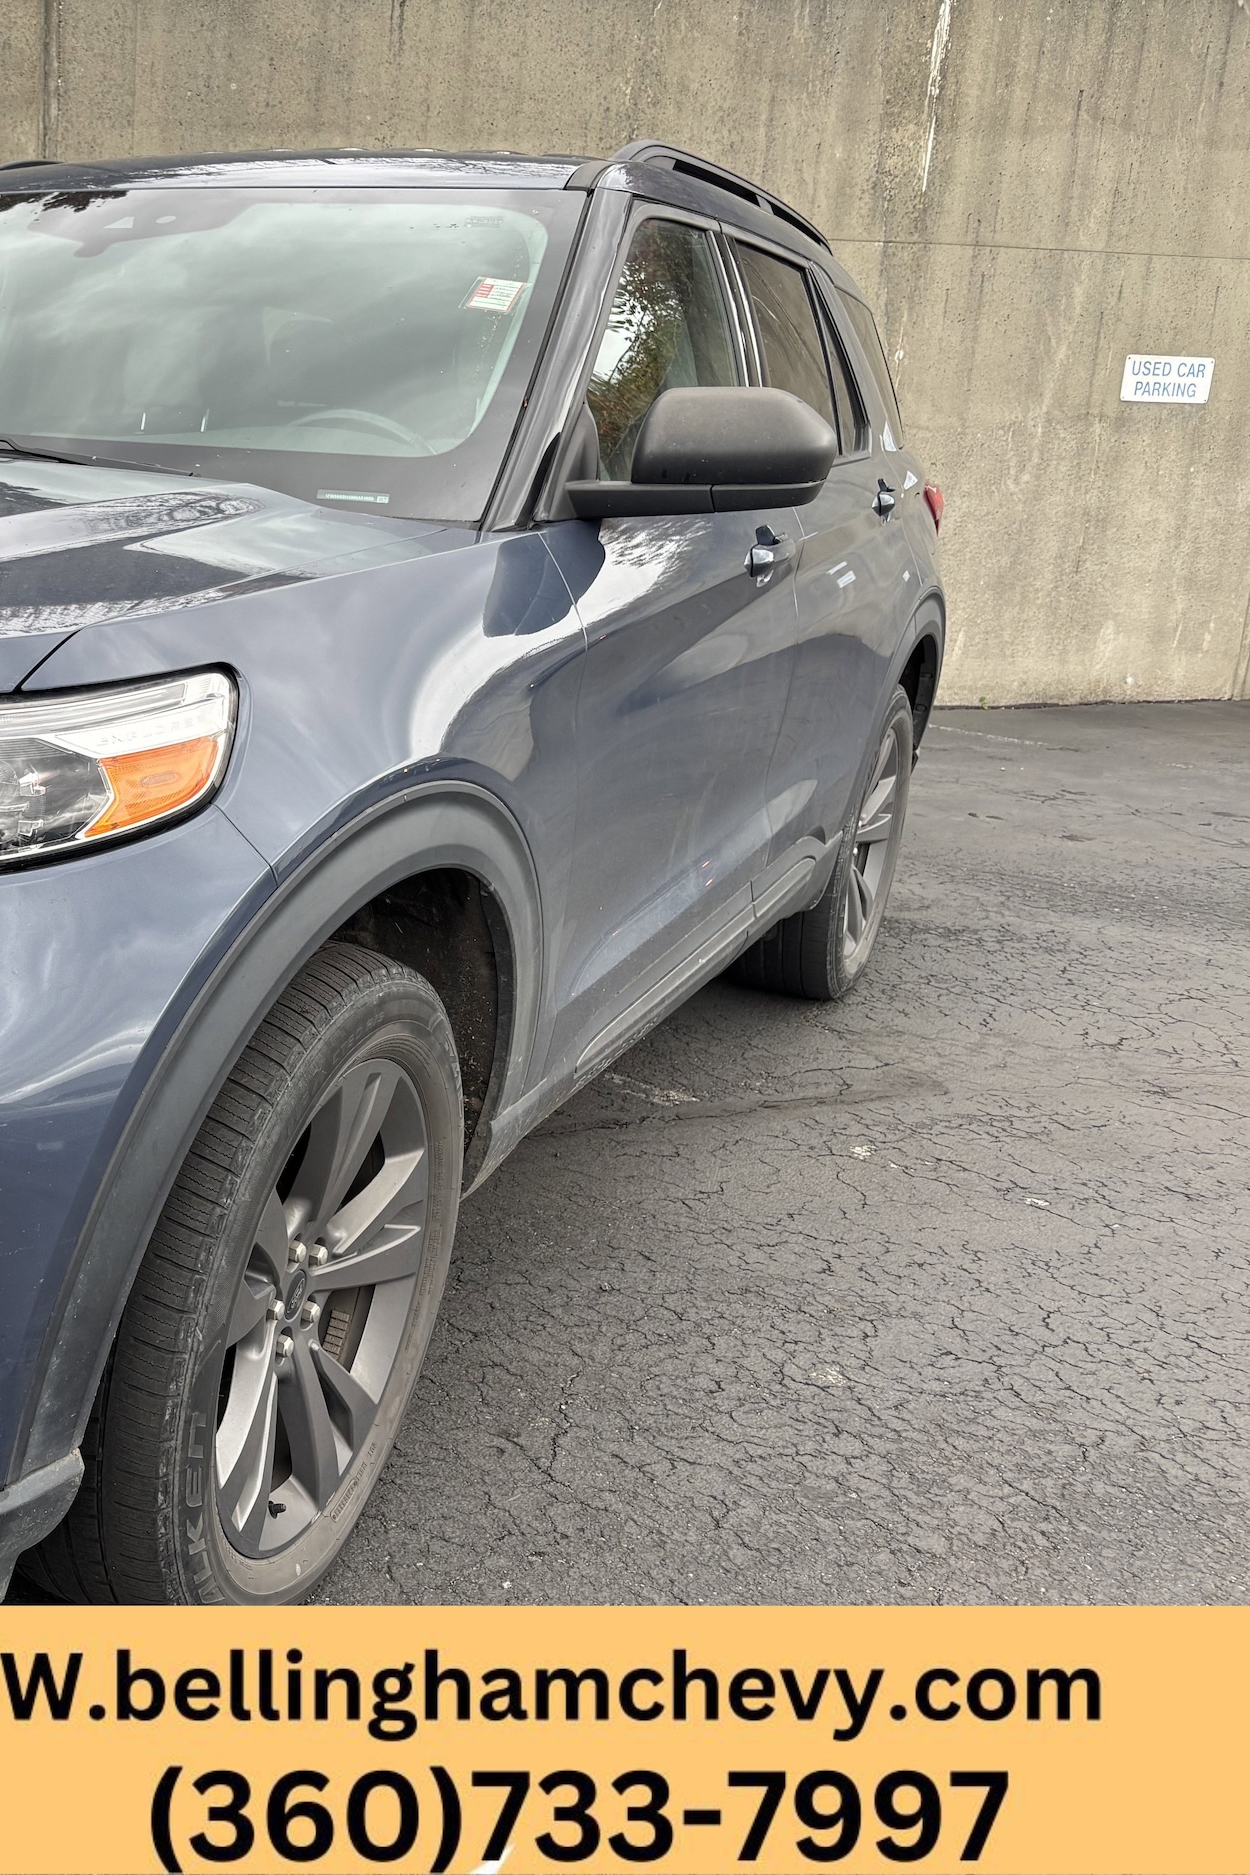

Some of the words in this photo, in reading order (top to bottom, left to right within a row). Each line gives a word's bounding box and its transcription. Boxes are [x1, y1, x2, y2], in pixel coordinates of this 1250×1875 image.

[1131, 360, 1172, 376] USED
[1177, 362, 1206, 378] CAR
[1134, 381, 1197, 398] PARKING
[185, 1411, 226, 1604] ALKEN
